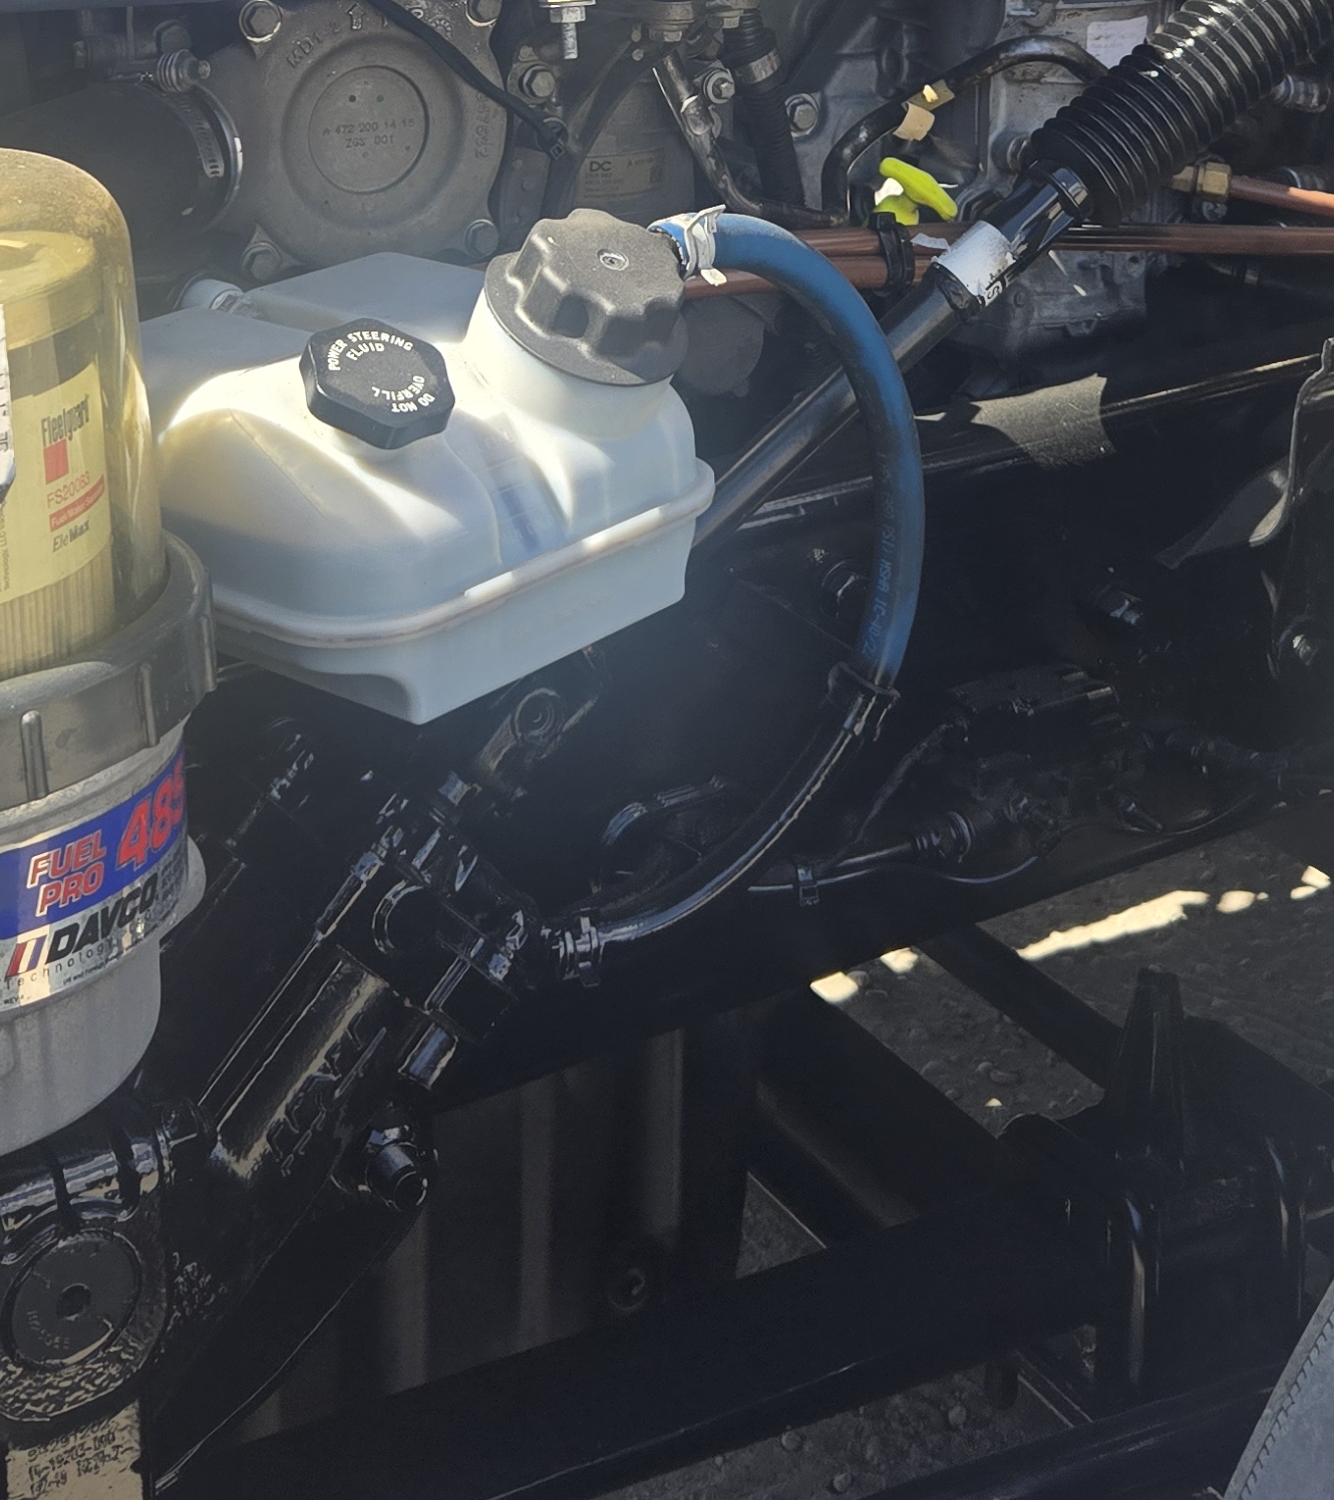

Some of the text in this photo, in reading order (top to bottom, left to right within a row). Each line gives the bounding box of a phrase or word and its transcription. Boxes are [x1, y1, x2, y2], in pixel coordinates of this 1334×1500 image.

[359, 121, 379, 133] 200
[327, 330, 414, 371] POWER STEERING
[346, 342, 385, 361] FLUID
[371, 375, 425, 401] OVERFILL
[391, 392, 436, 413] DO NOT
[41, 399, 90, 448] Fleetguard
[51, 514, 68, 528] Fuel
[52, 520, 91, 553] EleMax
[878, 558, 893, 593] MSHA
[26, 829, 107, 889] FUEL
[35, 862, 105, 917] PRO
[44, 872, 160, 966] DAVCO
[5, 937, 117, 991] Technology
